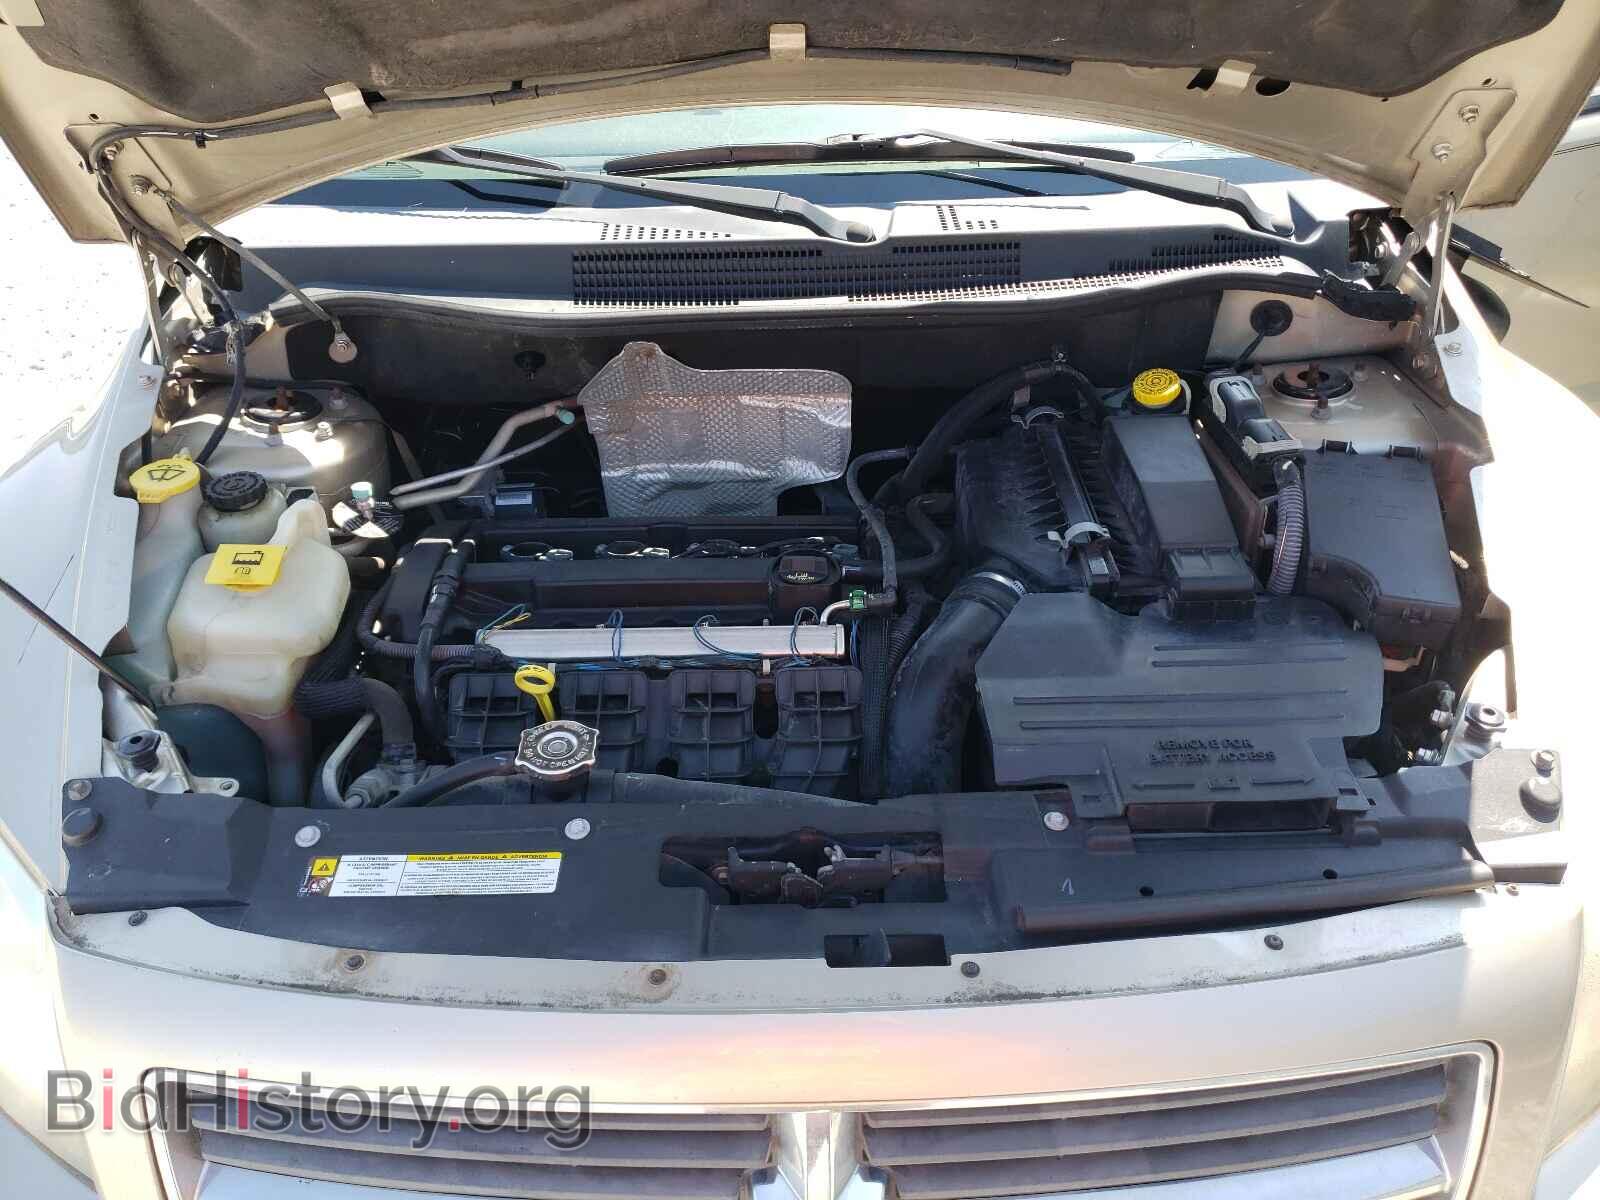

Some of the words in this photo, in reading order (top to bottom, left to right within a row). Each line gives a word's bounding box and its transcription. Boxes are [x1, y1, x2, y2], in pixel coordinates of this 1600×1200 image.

[1154, 737, 1220, 750] REMOVE
[1221, 736, 1254, 749] FOR
[1147, 751, 1209, 765] BATTERY
[1216, 750, 1276, 762] ACCESS
